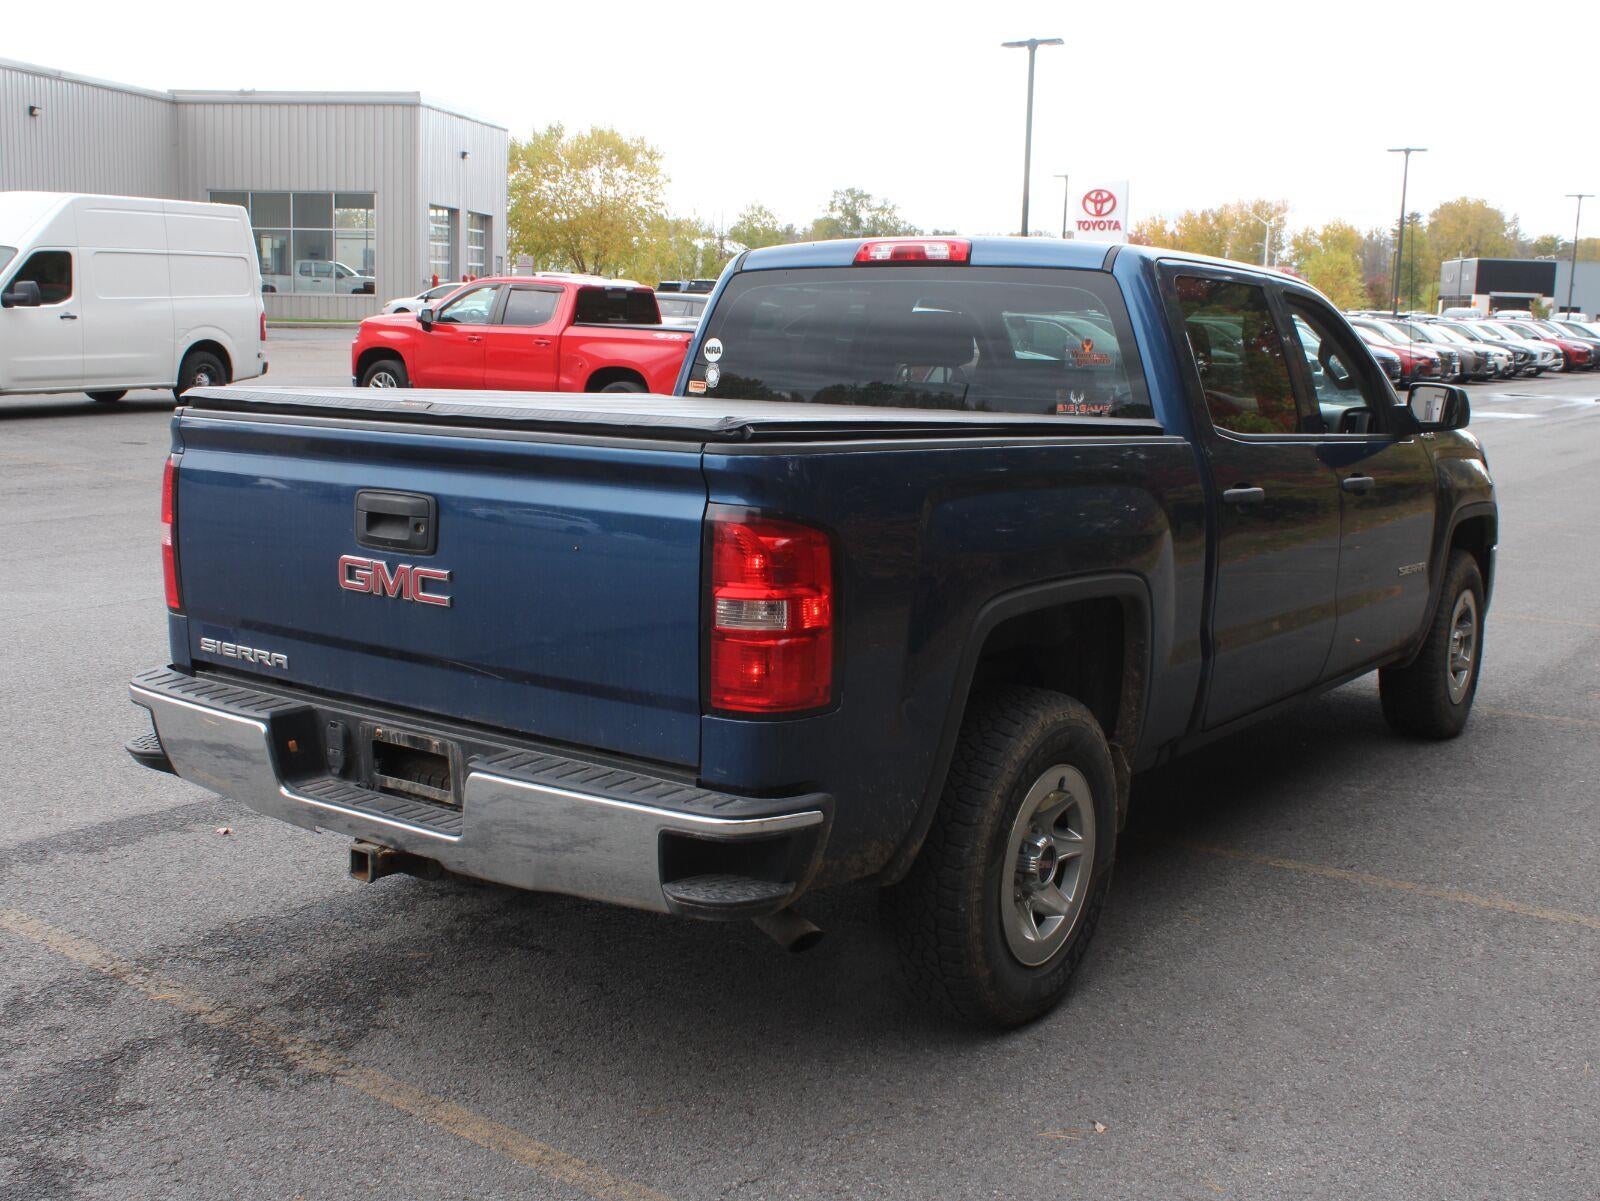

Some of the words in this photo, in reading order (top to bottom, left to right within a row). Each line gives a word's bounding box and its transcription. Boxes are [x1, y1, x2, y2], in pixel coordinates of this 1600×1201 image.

[1075, 220, 1121, 231] TOYOTA
[705, 346, 721, 355] NRA
[338, 555, 451, 607] GMC
[200, 637, 289, 670] SIERRA
